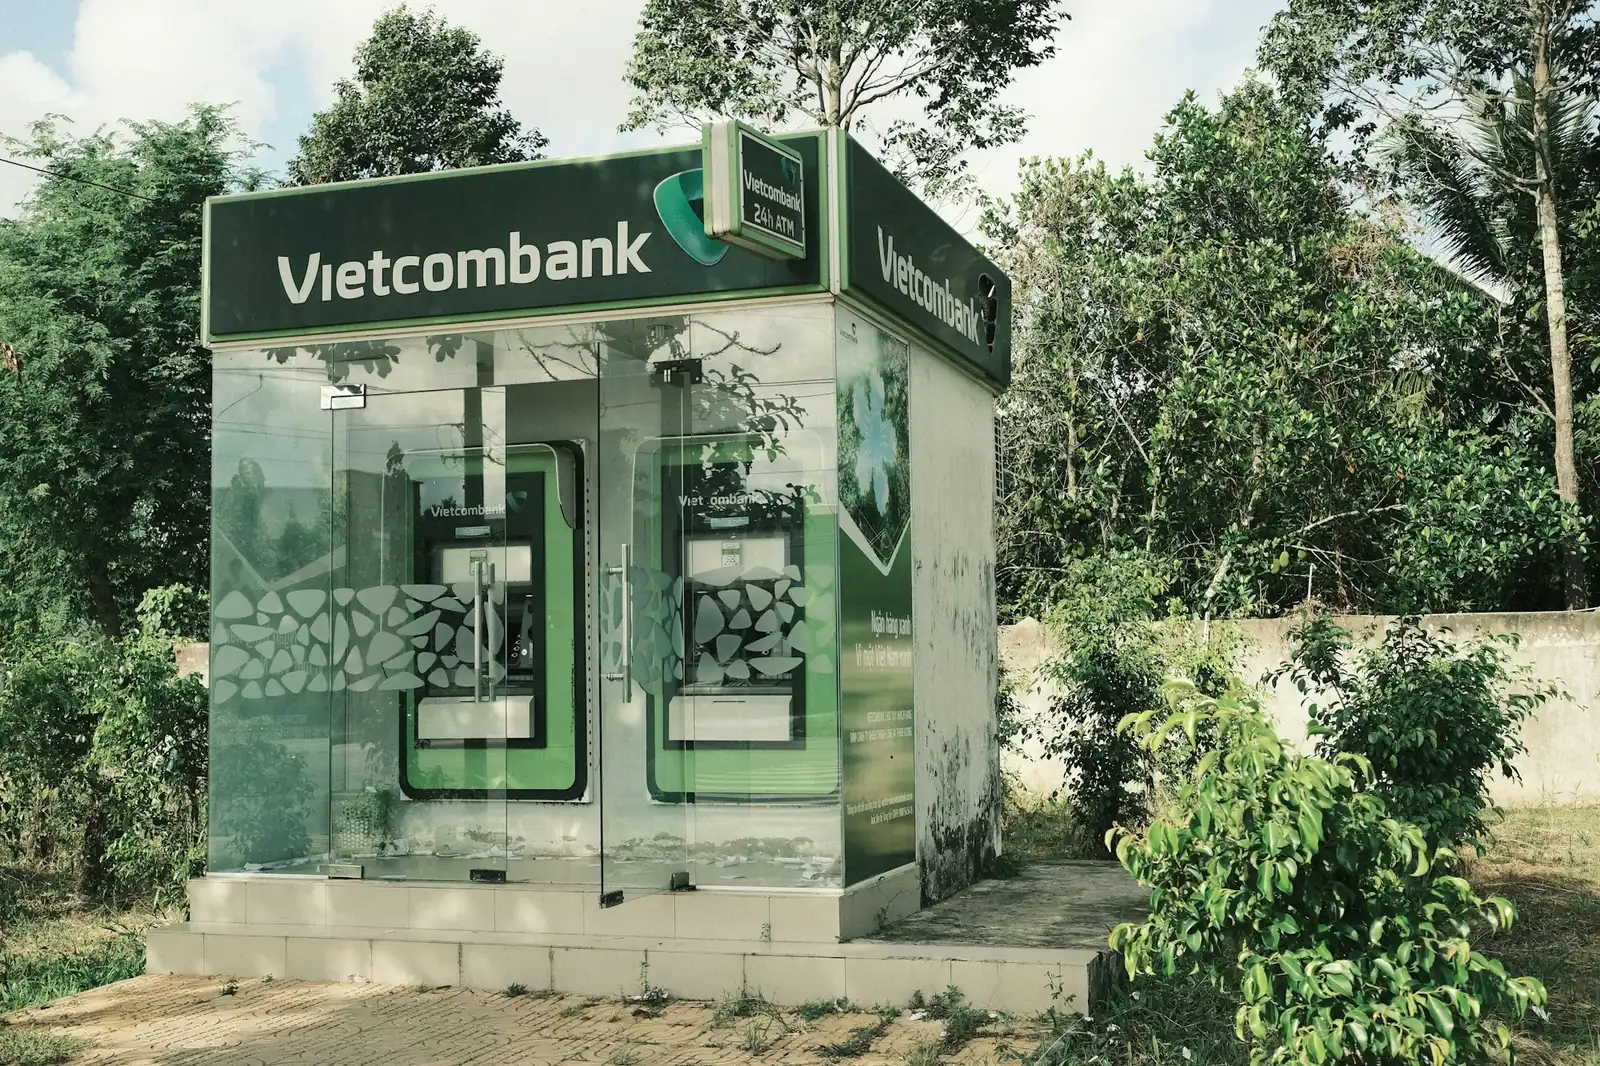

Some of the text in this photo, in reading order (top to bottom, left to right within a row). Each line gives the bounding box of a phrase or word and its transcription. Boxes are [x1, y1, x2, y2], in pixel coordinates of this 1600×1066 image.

[744, 168, 801, 213] Vietcombank
[753, 202, 795, 238] 24h ATM
[277, 220, 653, 305] Vietcombank
[877, 225, 980, 347] Vietcombank
[430, 503, 506, 518] Vietcombank
